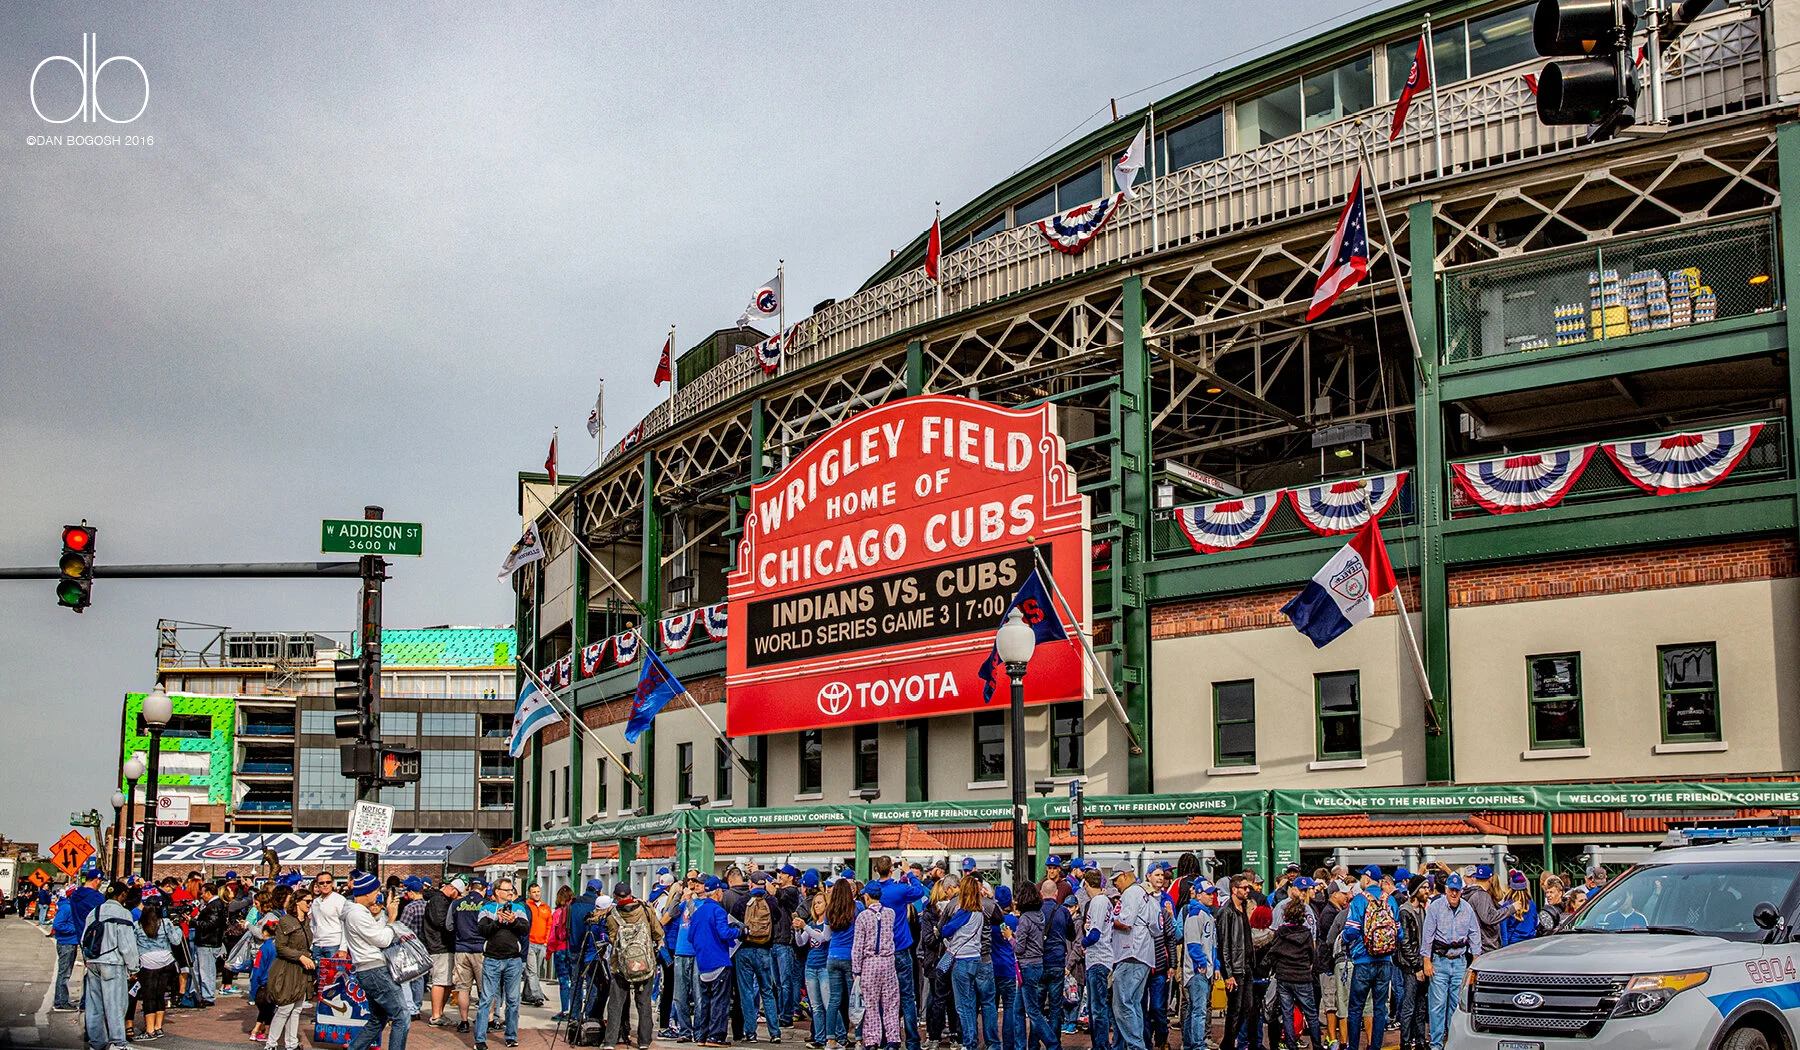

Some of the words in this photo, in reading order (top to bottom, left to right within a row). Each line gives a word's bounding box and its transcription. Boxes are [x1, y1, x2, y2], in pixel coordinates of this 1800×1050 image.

[759, 419, 905, 535] WRIGLEY
[922, 416, 1033, 473] FIELD
[827, 482, 896, 520] HOME
[915, 468, 950, 497] OF
[326, 525, 334, 535] W
[339, 524, 402, 539] ADDISON
[406, 528, 418, 538] ST
[348, 540, 381, 550] 3600
[388, 541, 396, 551] N
[759, 523, 907, 588] CHICAGO
[924, 494, 1035, 553] CUBS
[772, 585, 875, 628] INDIANS
[882, 577, 926, 607] VS.
[936, 557, 1018, 598] CUBS
[755, 629, 813, 656] WORLD
[816, 616, 878, 645] SERIES
[882, 607, 934, 634] GAME
[940, 604, 950, 625] 3
[965, 596, 1005, 621] 7:00
[855, 671, 959, 709] TOYOTA
[1314, 798, 1368, 807] WELCOME
[1370, 797, 1386, 806] TO
[1388, 797, 1410, 806] THE
[1412, 796, 1466, 805] FRIENDLY
[1468, 795, 1526, 804] CONFINES
[1569, 794, 1628, 803] WELCOME
[1630, 794, 1647, 803] TO
[1649, 793, 1673, 802] THE
[1676, 793, 1733, 802] FRIENDLY
[1737, 792, 1799, 801] CONFINES
[362, 804, 387, 815] NOTICE
[872, 810, 910, 819] WELCOME
[911, 810, 922, 818] TO
[923, 809, 939, 818] THE
[940, 808, 978, 817] FRIENDLY
[1100, 804, 1112, 813] TO
[1114, 804, 1131, 812] THE
[1133, 802, 1178, 811] FRIENDLY
[1179, 800, 1227, 810] CONFINES
[714, 815, 748, 824] WELCOME
[748, 815, 758, 823] TO
[759, 815, 773, 823] THE
[773, 813, 807, 822] FRIENDLY
[808, 812, 845, 821] CONFINES
[1745, 955, 1797, 984] 8904
[1517, 993, 1536, 1005] Ford
